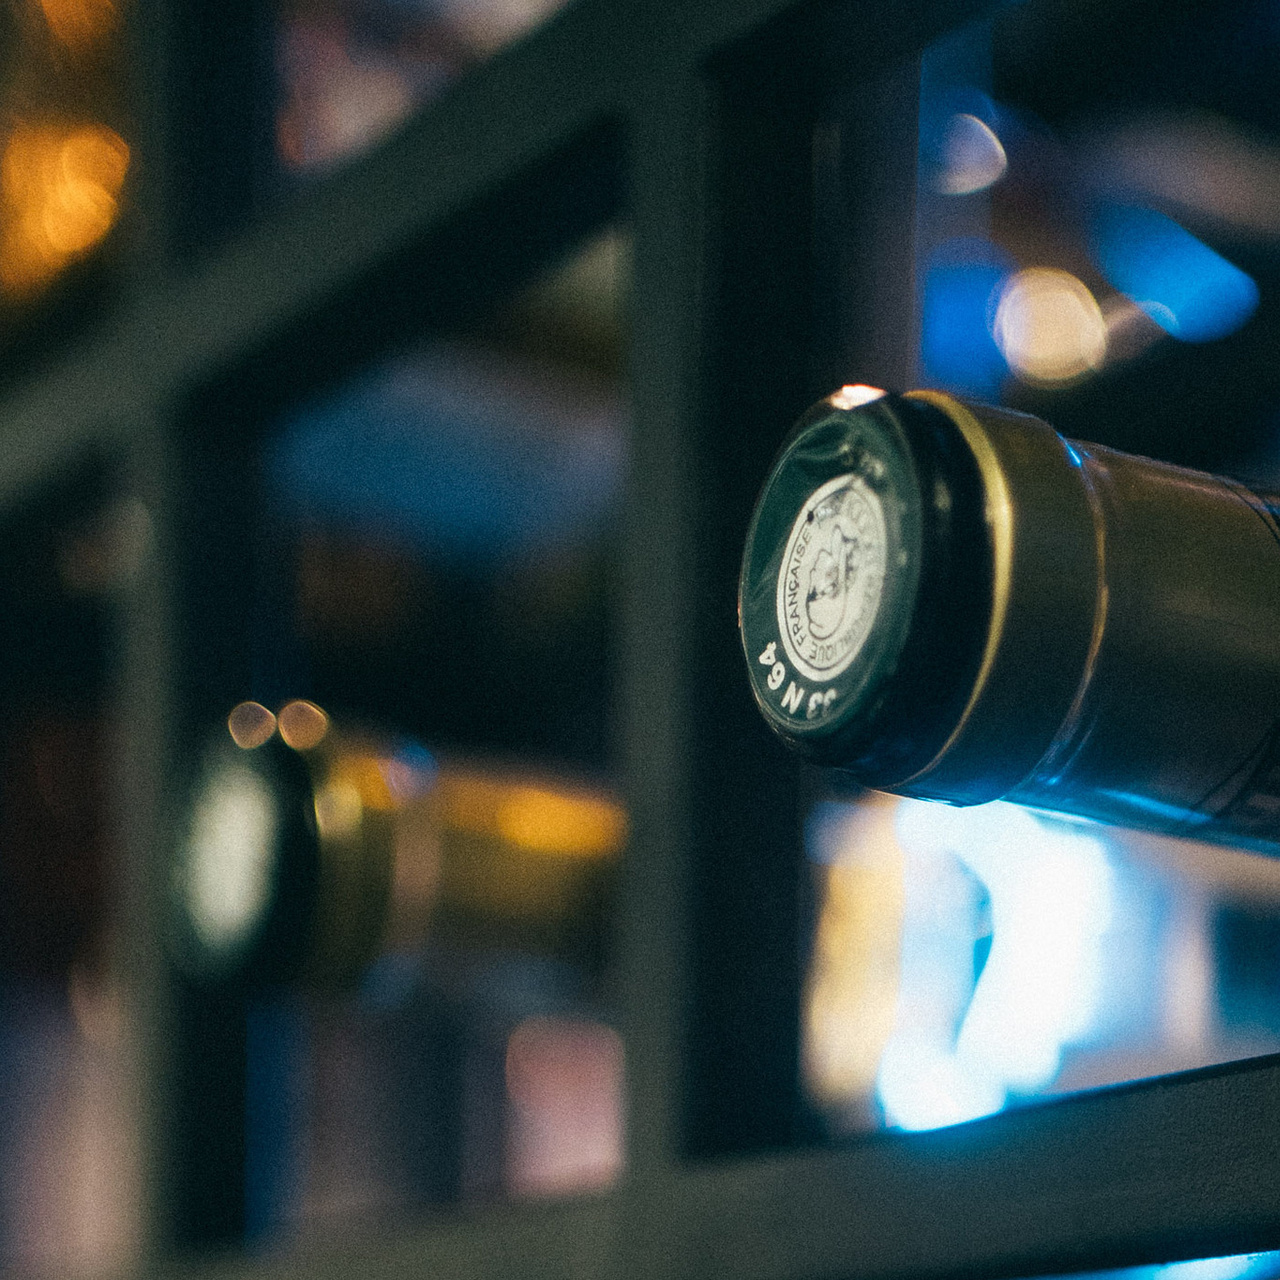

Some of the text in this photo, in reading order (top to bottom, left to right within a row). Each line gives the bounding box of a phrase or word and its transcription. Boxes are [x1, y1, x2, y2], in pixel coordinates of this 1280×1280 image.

[787, 530, 811, 646] FRANÇAISE
[758, 641, 786, 690] 64
[780, 682, 805, 714] N
